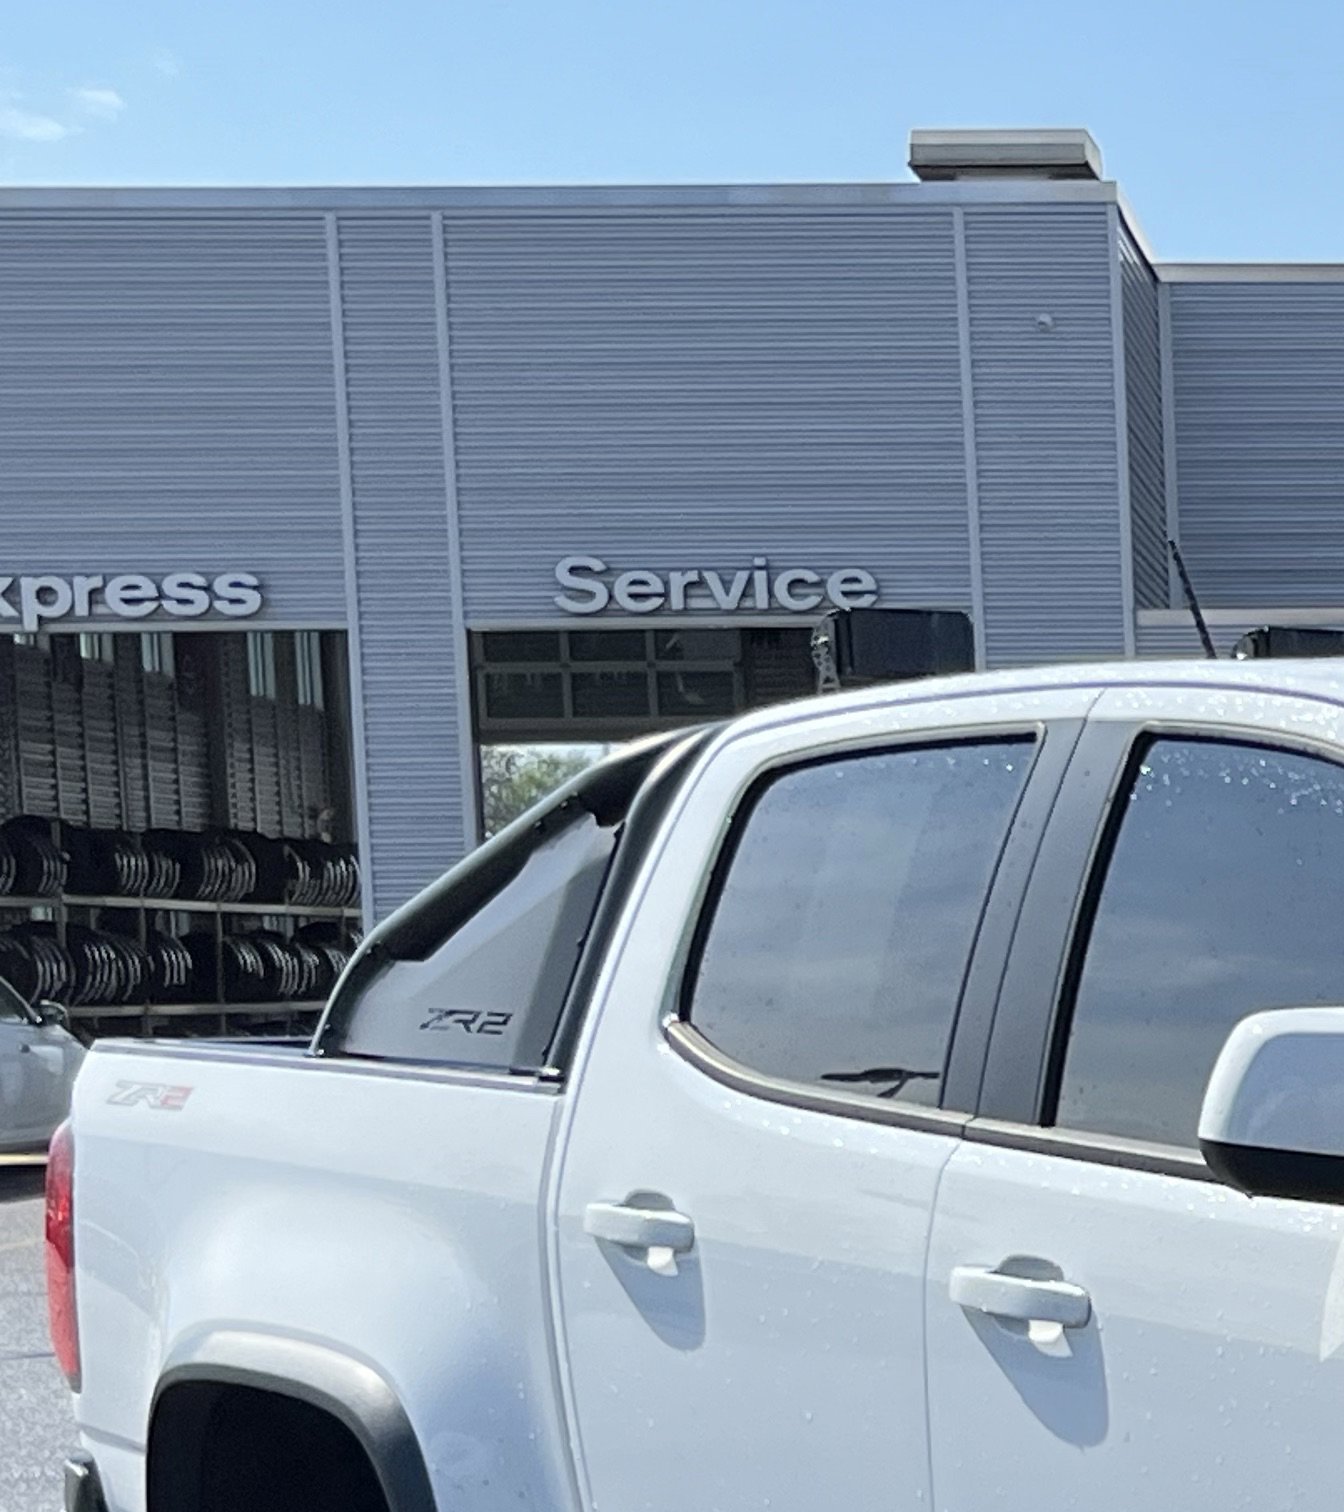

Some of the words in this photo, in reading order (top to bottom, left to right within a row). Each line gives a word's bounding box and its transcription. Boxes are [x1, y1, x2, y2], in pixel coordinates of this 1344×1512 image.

[553, 556, 880, 614] Service
[418, 1006, 514, 1036] ZR2
[105, 1078, 194, 1112] ZR2
